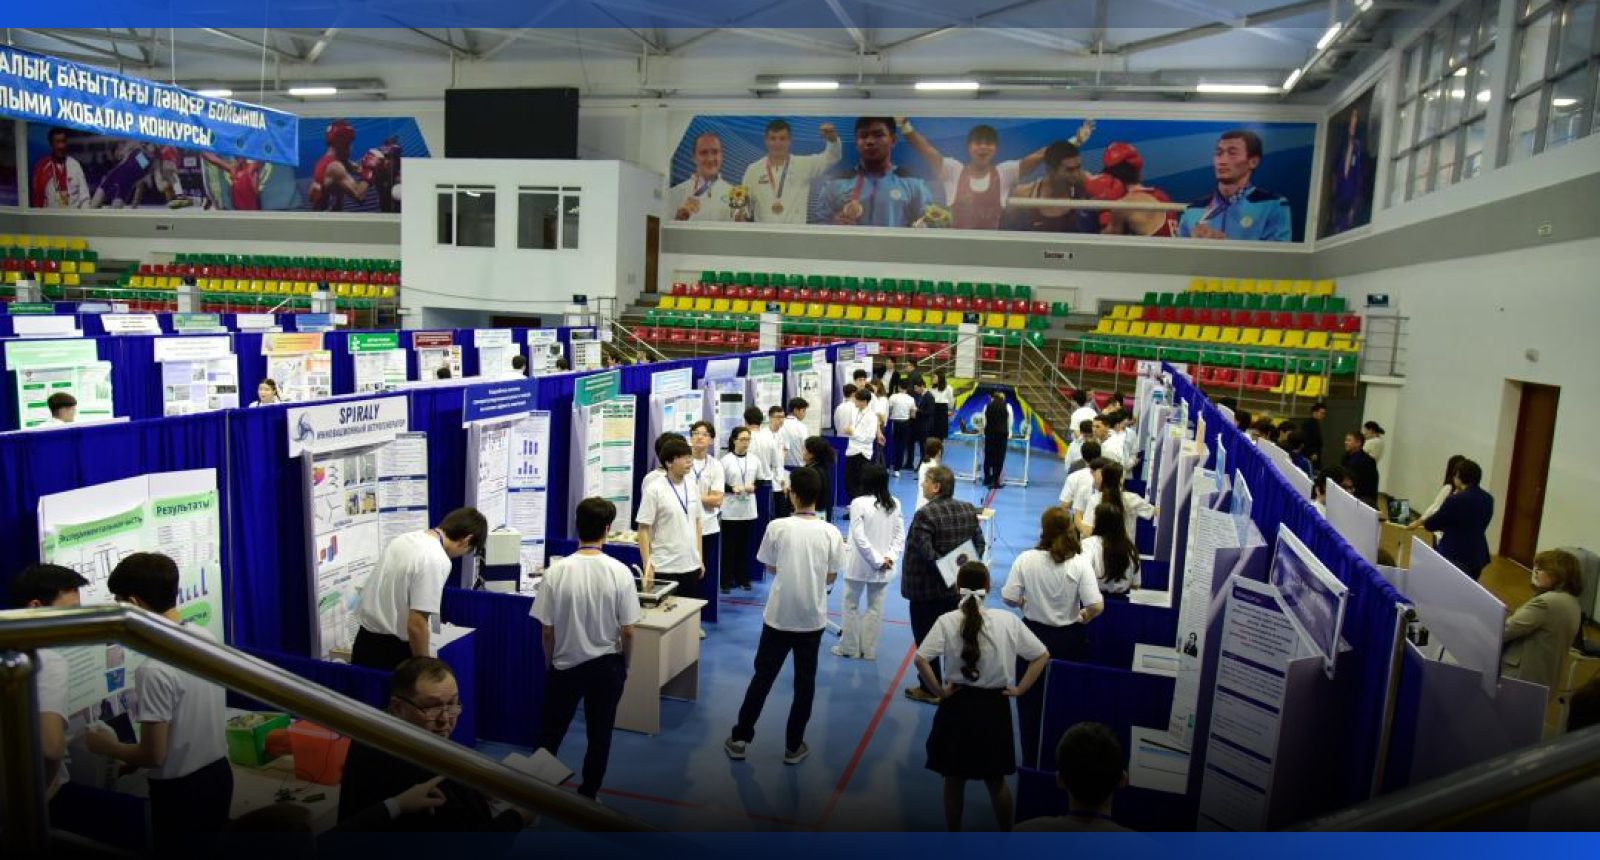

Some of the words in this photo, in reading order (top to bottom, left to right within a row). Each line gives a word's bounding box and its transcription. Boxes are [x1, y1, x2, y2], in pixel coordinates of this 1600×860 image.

[57, 64, 149, 106] БАҒЫТТАҒЫ
[152, 87, 204, 117] ПӘНДЕР
[208, 100, 266, 131] БОЙЫНША
[57, 97, 134, 133] ЖОБАЛАР
[138, 115, 213, 147] КОНКУРСЫ
[339, 403, 380, 424] SPIRALY
